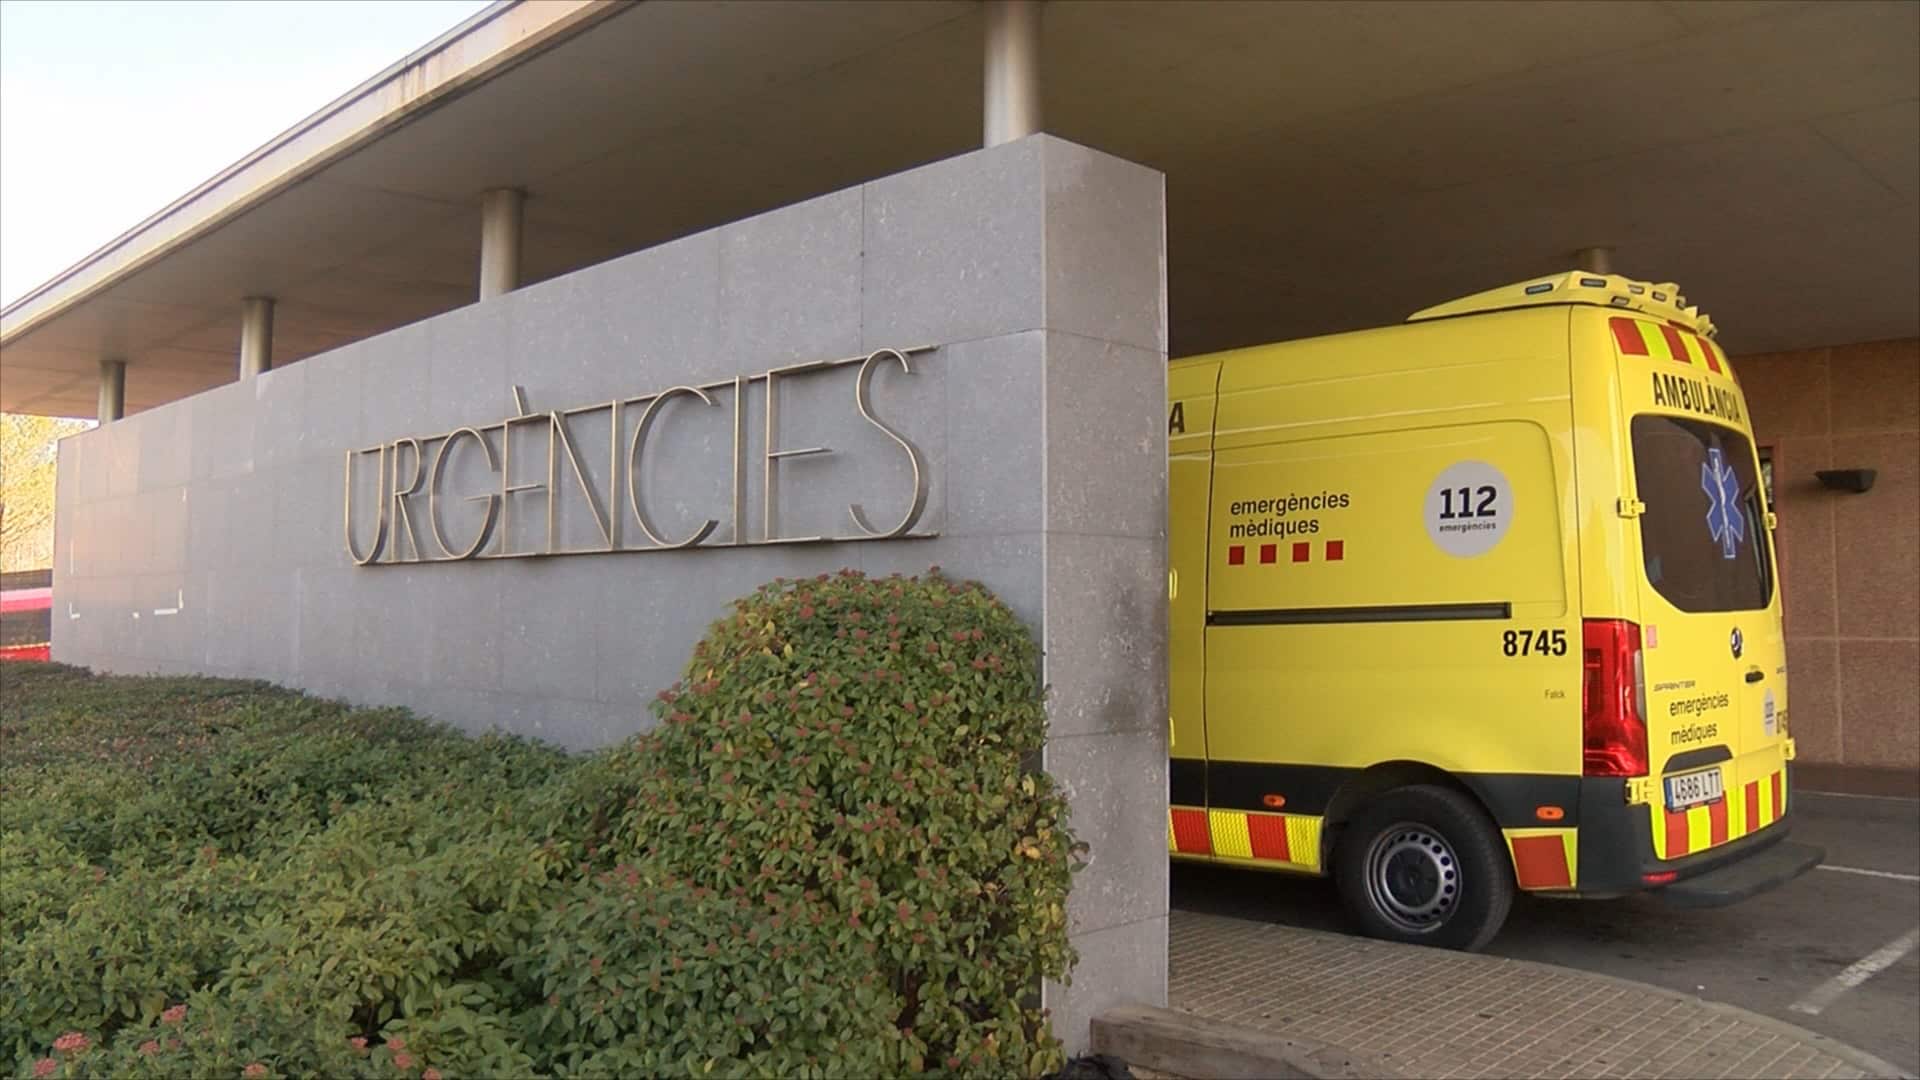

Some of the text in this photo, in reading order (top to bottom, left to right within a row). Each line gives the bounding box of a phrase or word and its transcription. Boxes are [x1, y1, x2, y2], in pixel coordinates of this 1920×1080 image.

[1652, 372, 1742, 424] AMBULÀNCIA
[345, 344, 937, 566] URGÈNCIES
[1230, 491, 1350, 516] emergències
[1440, 485, 1497, 519] 112
[1230, 518, 1319, 539] mèdiques
[1503, 629, 1567, 656] 8745
[1669, 691, 1729, 716] emergències
[1671, 723, 1718, 745] mèdiques
[1674, 777, 1700, 801] 4686
